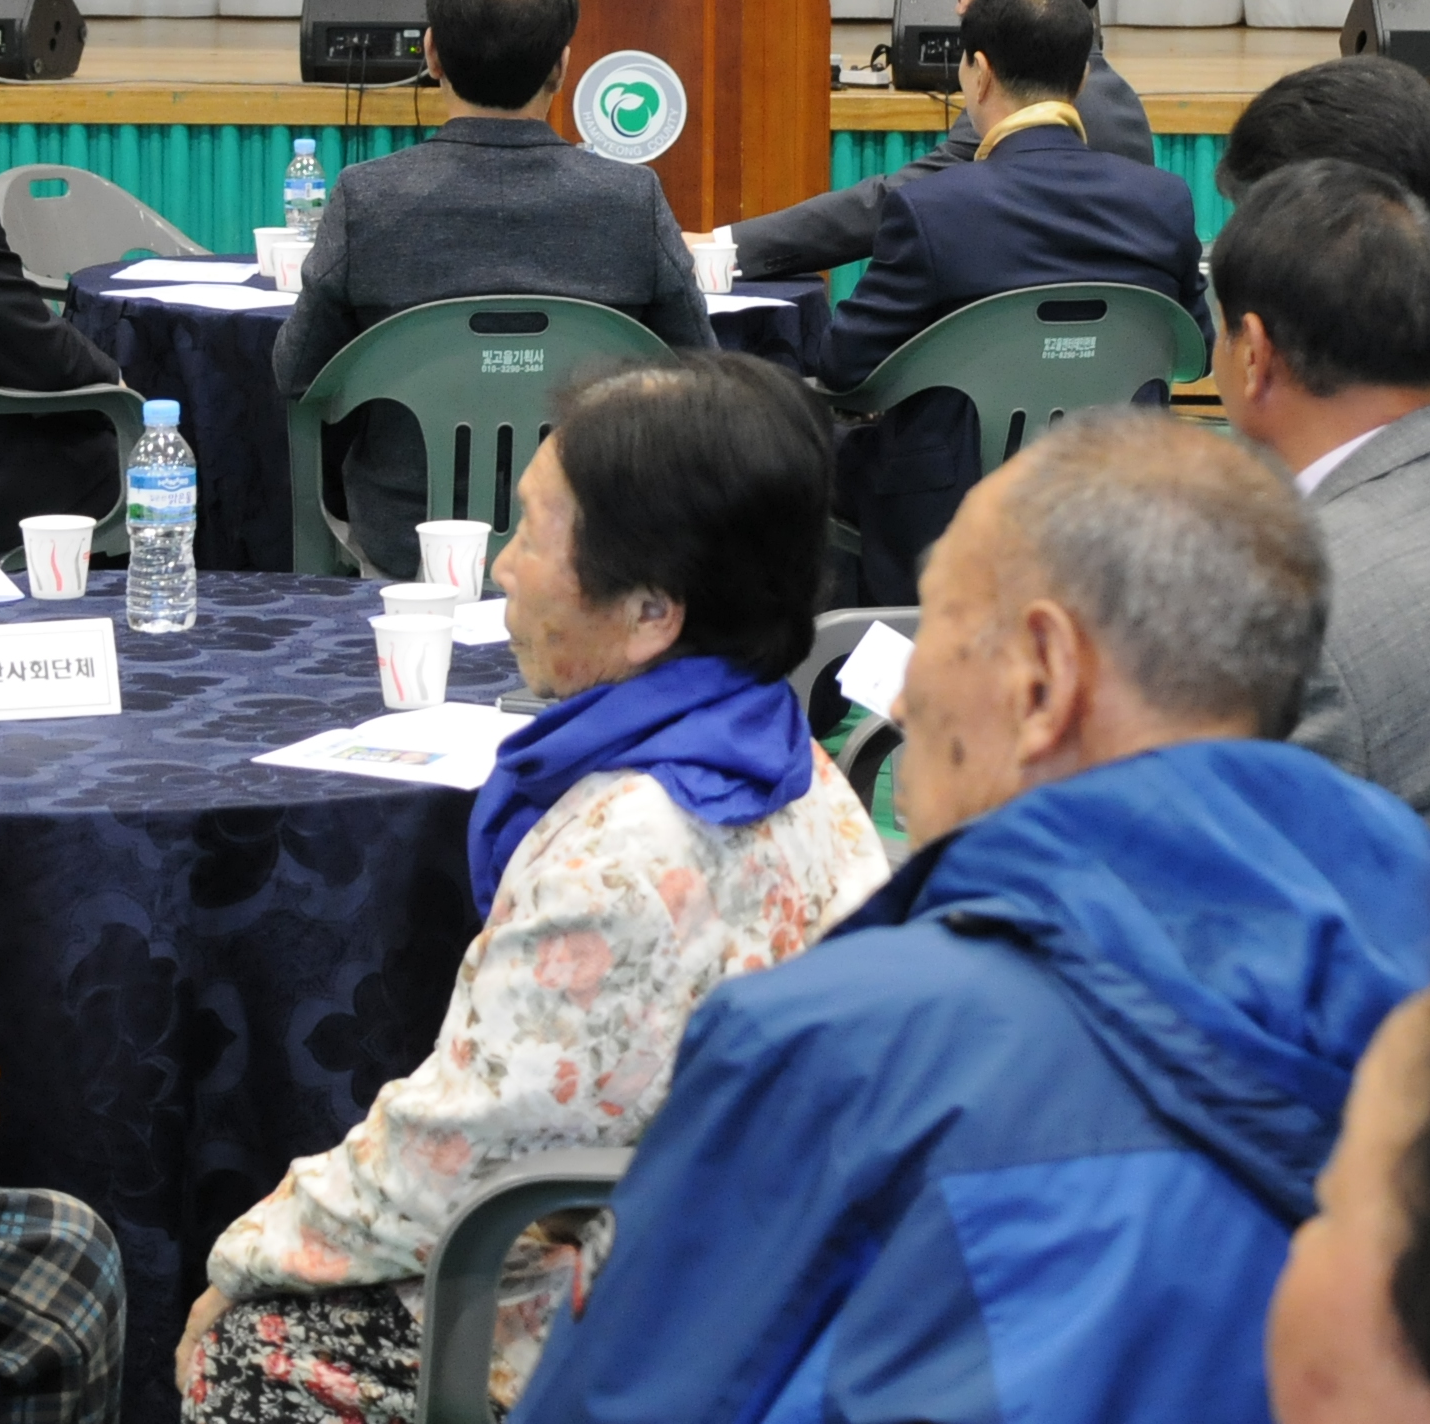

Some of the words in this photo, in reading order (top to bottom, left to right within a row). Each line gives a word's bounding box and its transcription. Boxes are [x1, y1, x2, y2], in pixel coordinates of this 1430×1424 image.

[583, 110, 643, 156] HAMPYEONG
[646, 106, 680, 152] COUNTY
[482, 349, 544, 365] 빛고을기획사
